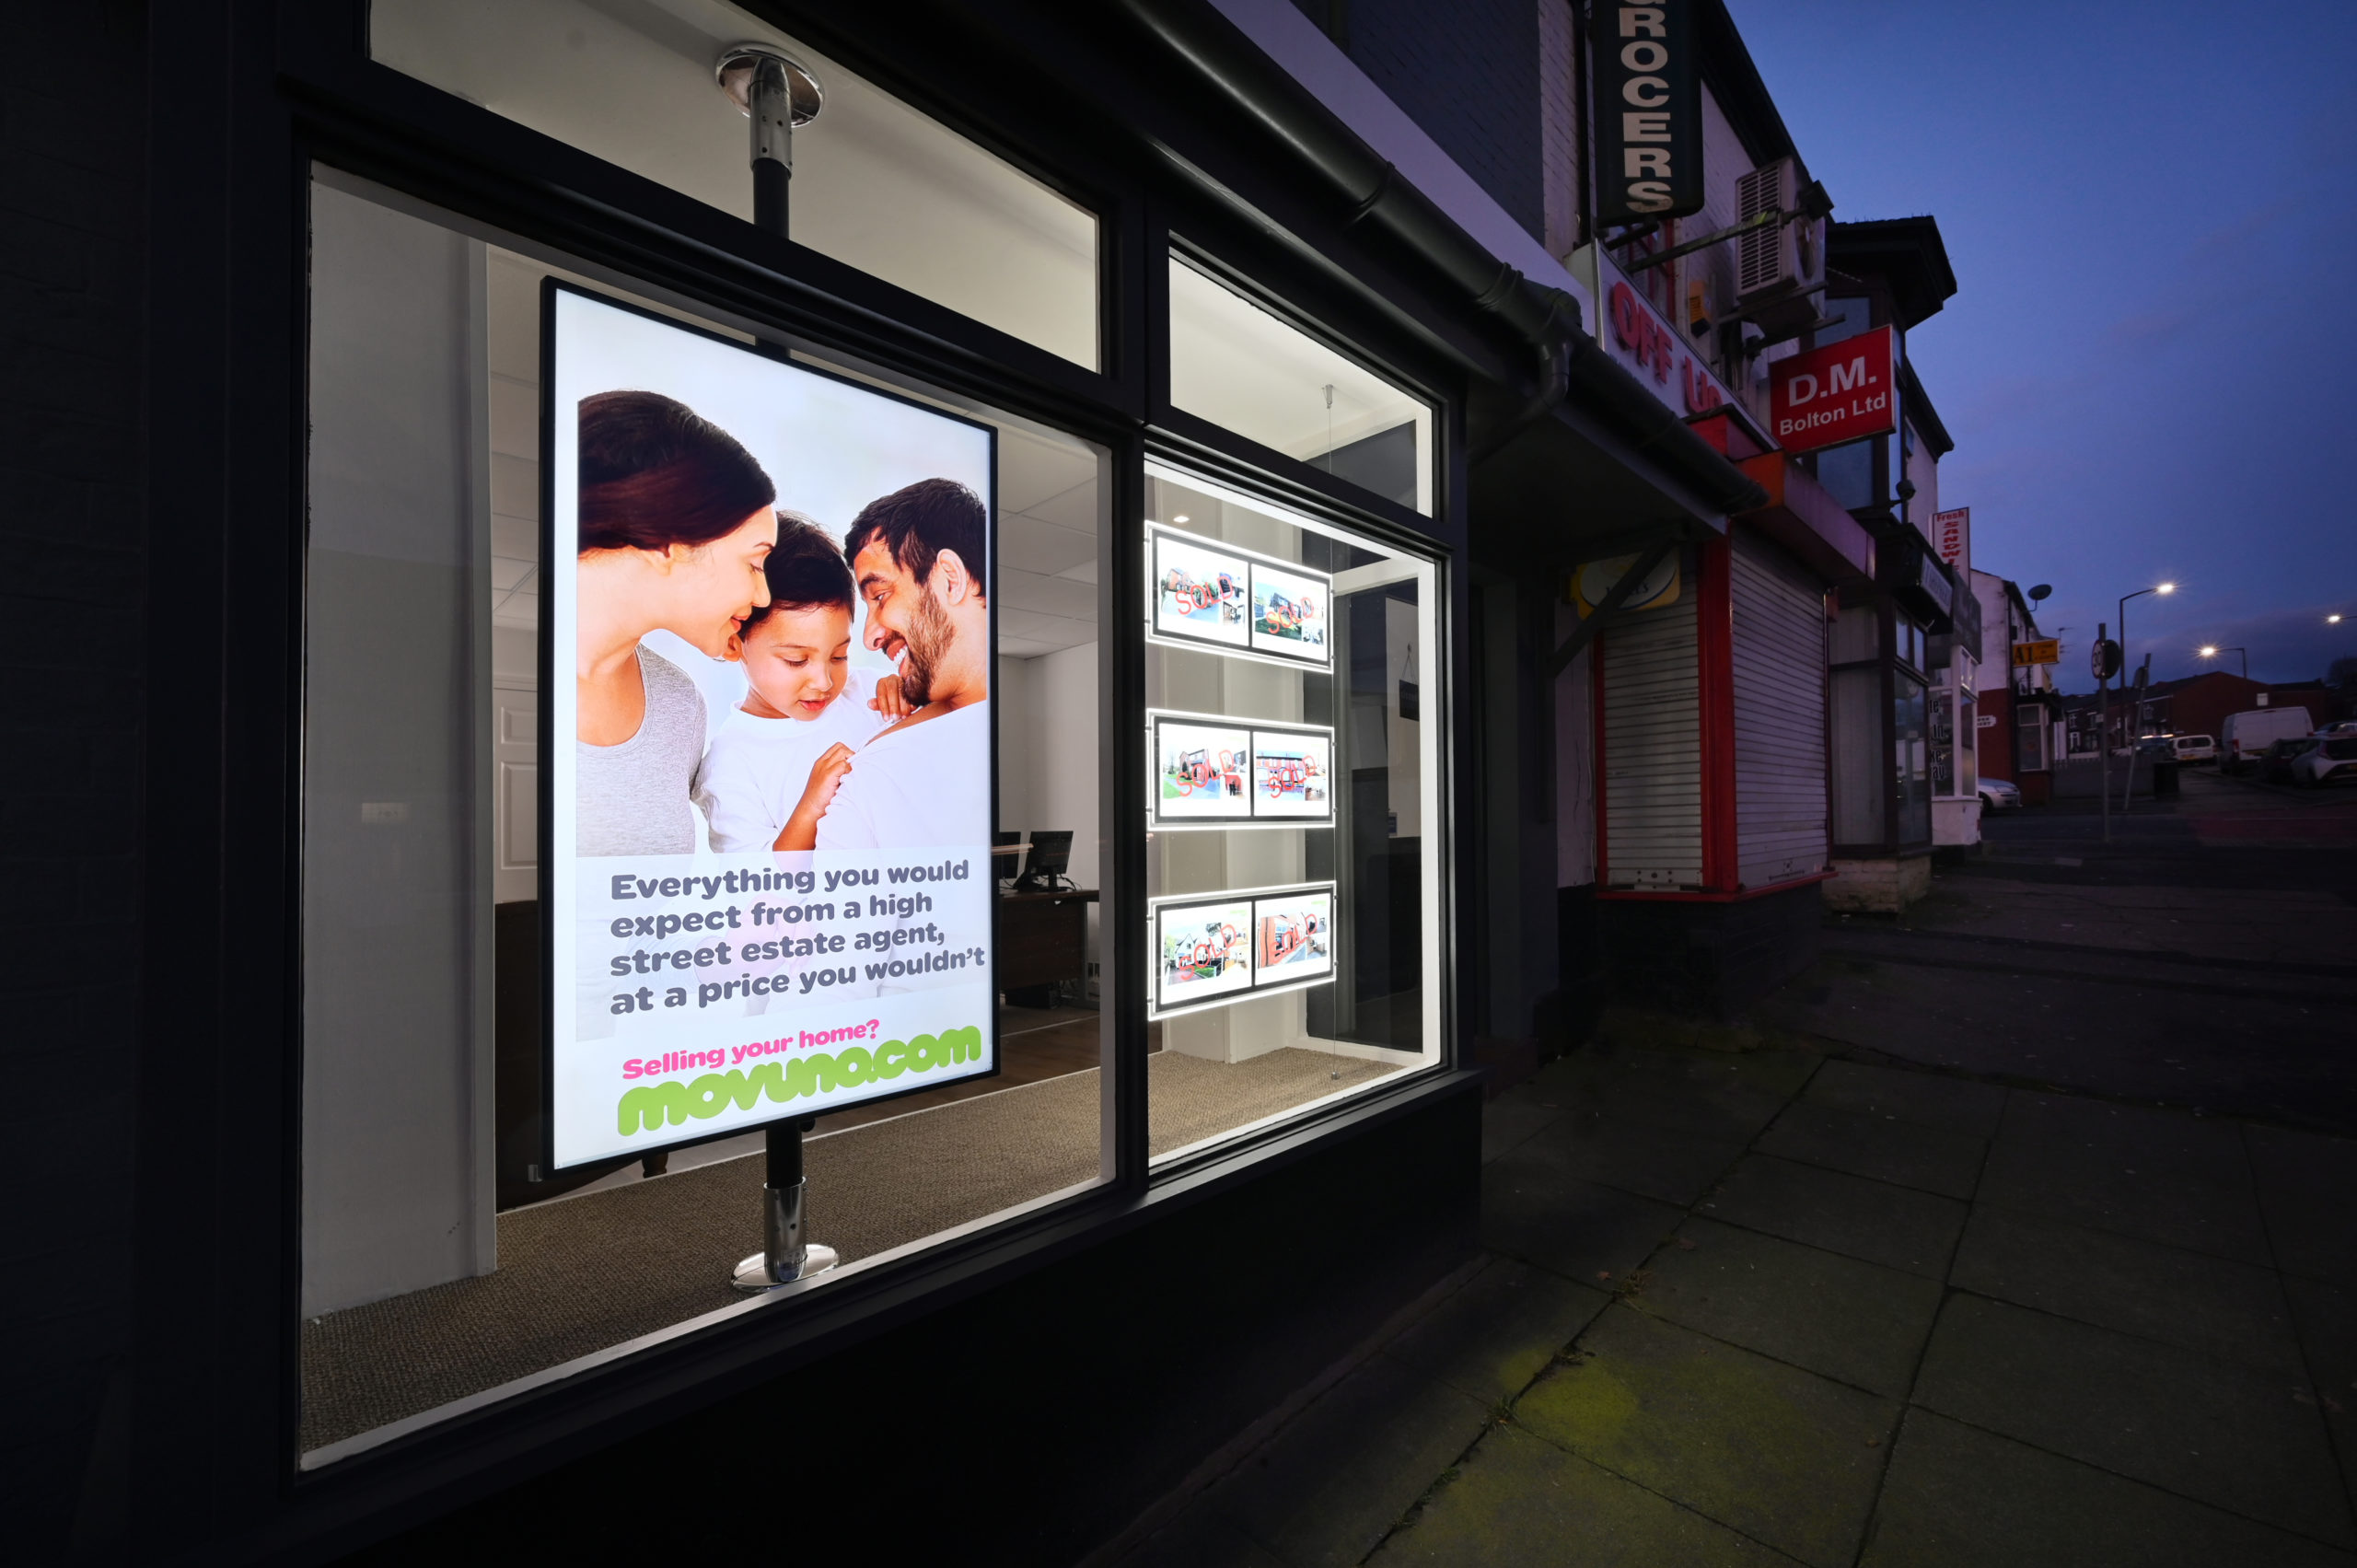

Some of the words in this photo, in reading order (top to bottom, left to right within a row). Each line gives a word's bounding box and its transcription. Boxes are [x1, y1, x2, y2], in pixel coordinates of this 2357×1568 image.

[1618, 0, 1674, 214] ROCERS
[1612, 281, 1673, 384] OFF
[1787, 355, 1877, 408] D.M.
[1779, 407, 1846, 436] Bolton
[1852, 391, 1887, 416] Ltd
[1936, 510, 1965, 522] Fresh
[1175, 575, 1234, 615] SOLD
[1265, 596, 1315, 634] SOLD
[1176, 749, 1235, 797] SOLD
[1268, 755, 1317, 799] SOLD
[611, 867, 816, 900] Everything
[824, 868, 879, 892] you
[887, 859, 969, 884] would
[610, 905, 741, 939] expect
[750, 901, 835, 926] from
[842, 901, 861, 919] a
[869, 891, 933, 919] high
[610, 941, 732, 976] street
[741, 933, 846, 962] estate
[853, 923, 945, 952] agent,
[1178, 923, 1237, 981] SOLD
[610, 986, 654, 1015] at
[664, 987, 687, 1007] a
[698, 972, 790, 1008] price
[799, 966, 856, 994] you
[865, 947, 985, 981] wouldn’t
[621, 1048, 726, 1079] Selling
[731, 1037, 794, 1064] your
[798, 1018, 880, 1049] home?
